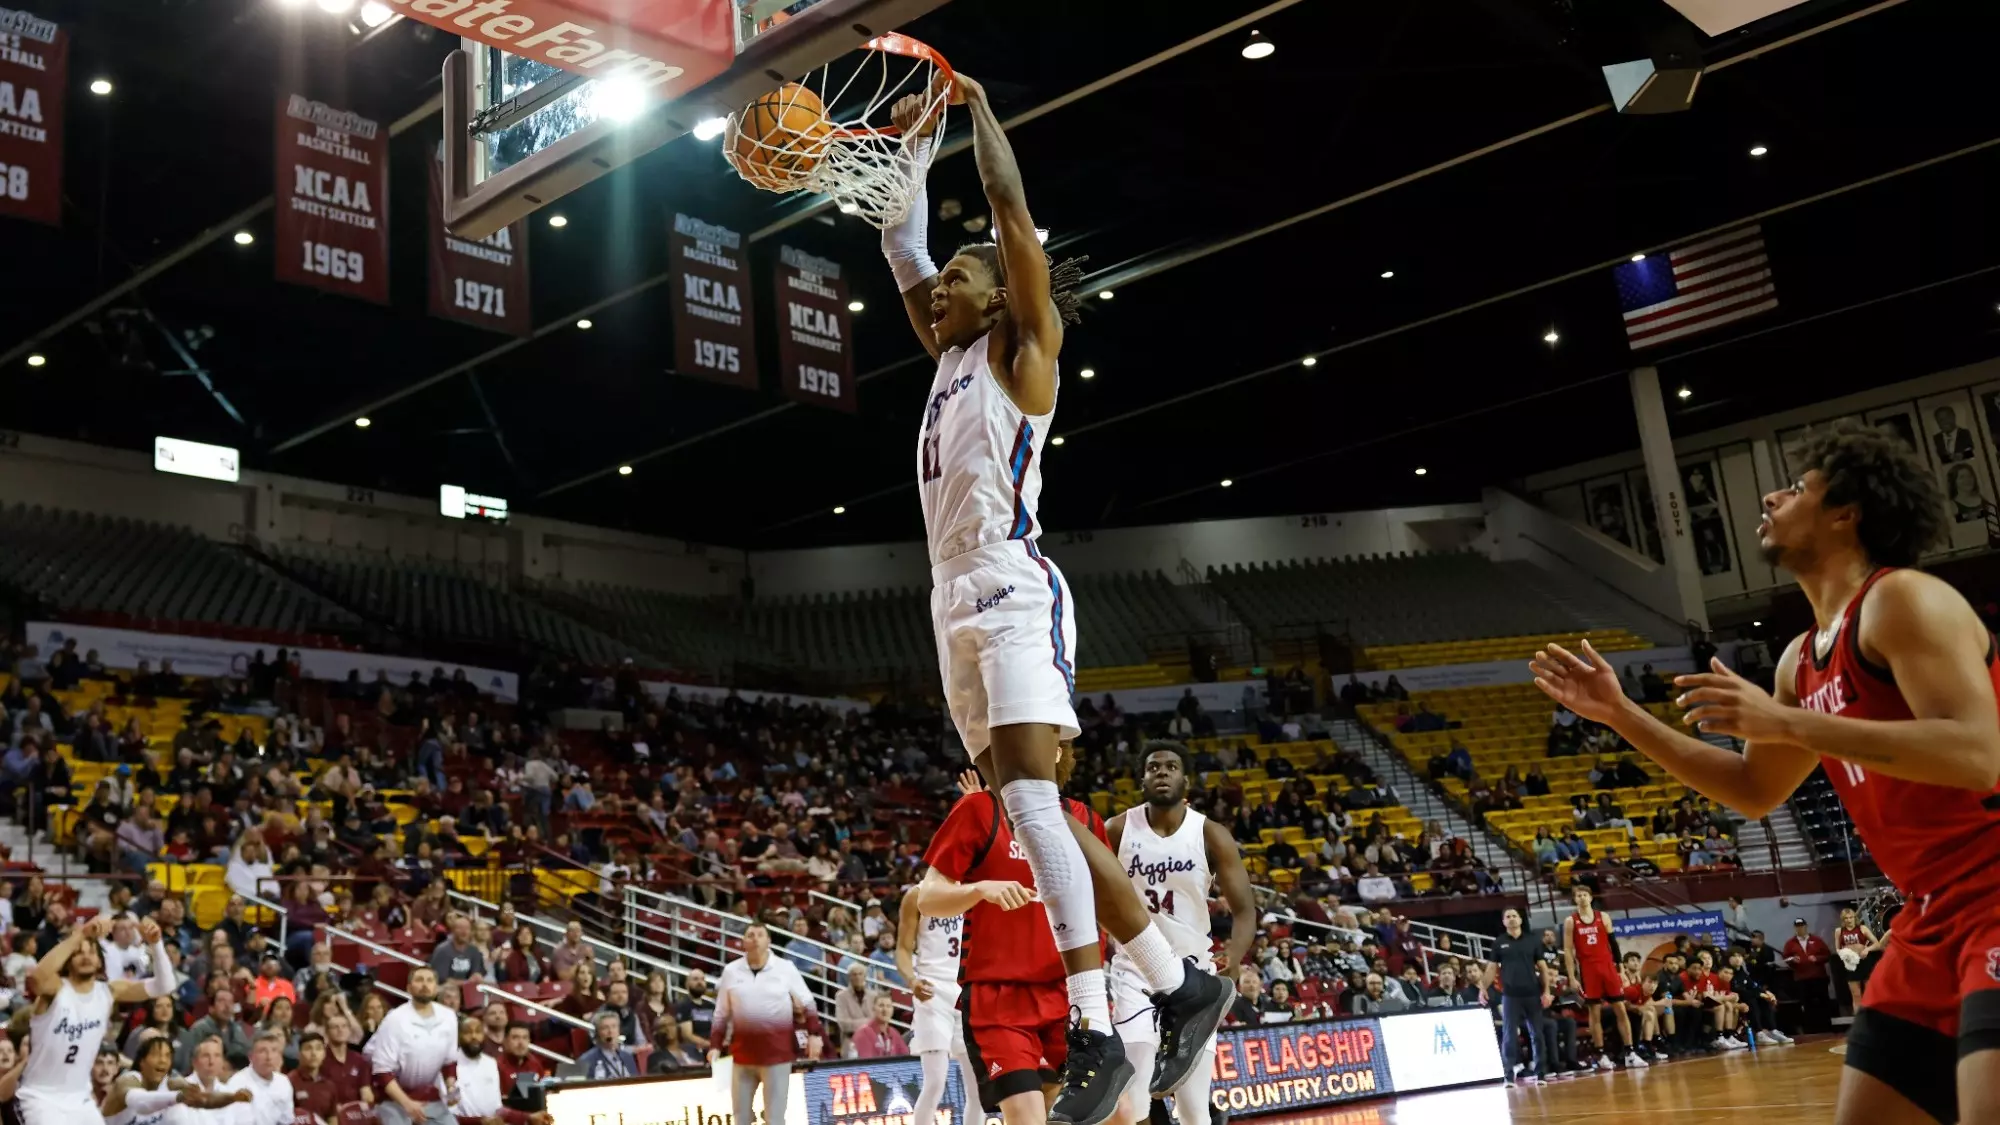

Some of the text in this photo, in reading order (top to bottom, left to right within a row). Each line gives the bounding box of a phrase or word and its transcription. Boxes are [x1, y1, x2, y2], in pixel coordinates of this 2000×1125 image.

[391, 0, 686, 88] ate Farm
[297, 132, 371, 165] BASKETBALL
[294, 164, 372, 212] NCAA
[303, 240, 364, 283] 1969
[445, 237, 512, 266] TOURNAMENT
[683, 245, 738, 271] BASKETBALL
[454, 277, 506, 318] 1971
[684, 272, 741, 312] NCAA
[788, 276, 838, 300] BASKETBALL
[686, 302, 741, 327] TOURNAMENT
[788, 302, 841, 339] NCAA
[694, 338, 740, 374] 1975
[791, 330, 842, 354] TOURNAMENT
[799, 364, 840, 399] 1979
[1668, 491, 1684, 537] SOUTH
[976, 584, 1015, 613] Aggies
[1127, 854, 1196, 886] Aggies
[1145, 889, 1174, 916] 34
[1636, 922, 1660, 931] where
[1662, 919, 1675, 928] the
[1676, 918, 1704, 928] Aggies
[1705, 915, 1719, 926] go!
[64, 1045, 79, 1064] 2
[1244, 1027, 1375, 1077] FLAGSHIP
[828, 1072, 877, 1116] ZIA
[1212, 1069, 1376, 1112] COUNTRY.COM
